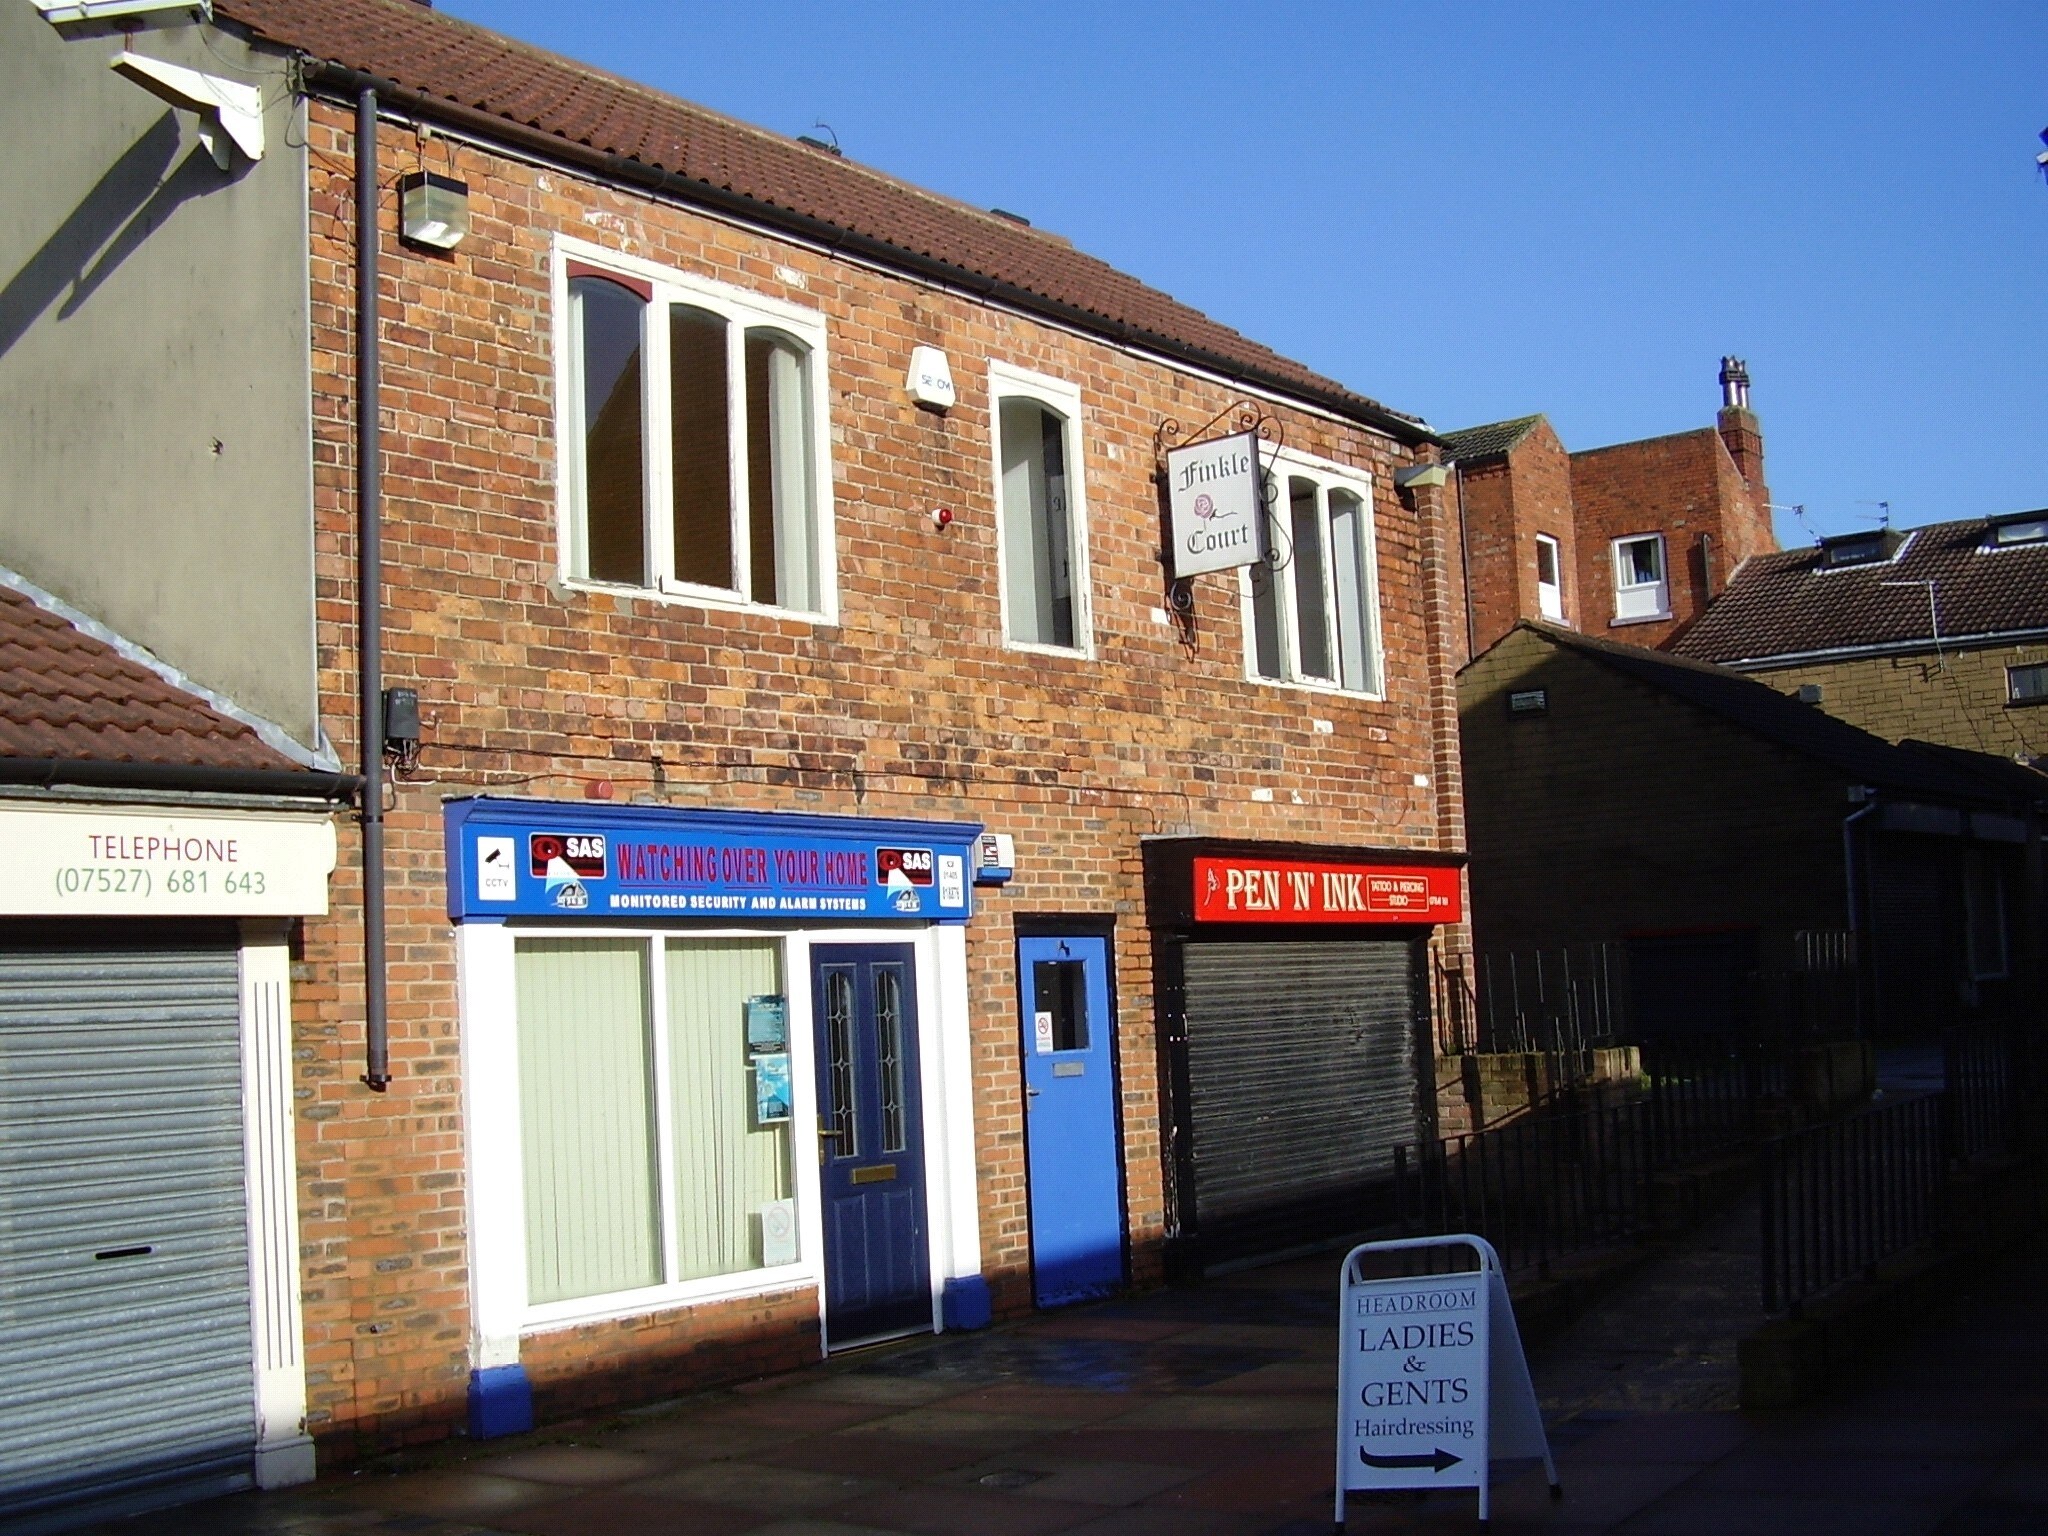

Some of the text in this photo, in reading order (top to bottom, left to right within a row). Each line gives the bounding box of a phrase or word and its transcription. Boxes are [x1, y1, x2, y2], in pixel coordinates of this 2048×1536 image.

[1178, 453, 1249, 492] Finkle
[1187, 524, 1248, 555] Court
[89, 835, 238, 862] TELEPHONE
[566, 837, 604, 858] SAS
[902, 852, 931, 870] SAS
[617, 843, 868, 886] WATCHING OVER YOUR HOME
[56, 867, 266, 897] (07527) 681 643
[485, 878, 509, 887] CCTV
[1226, 869, 1367, 912] PEN 'N' INK
[610, 894, 866, 911] MONITORED SECURITY AND ALARM SYSTEMS
[1357, 1291, 1476, 1314] HEADROOM
[1358, 1321, 1474, 1352] LADIES
[1403, 1355, 1426, 1373] &
[1361, 1377, 1468, 1407] GENTS
[1355, 1416, 1474, 1439] Hairdressing
